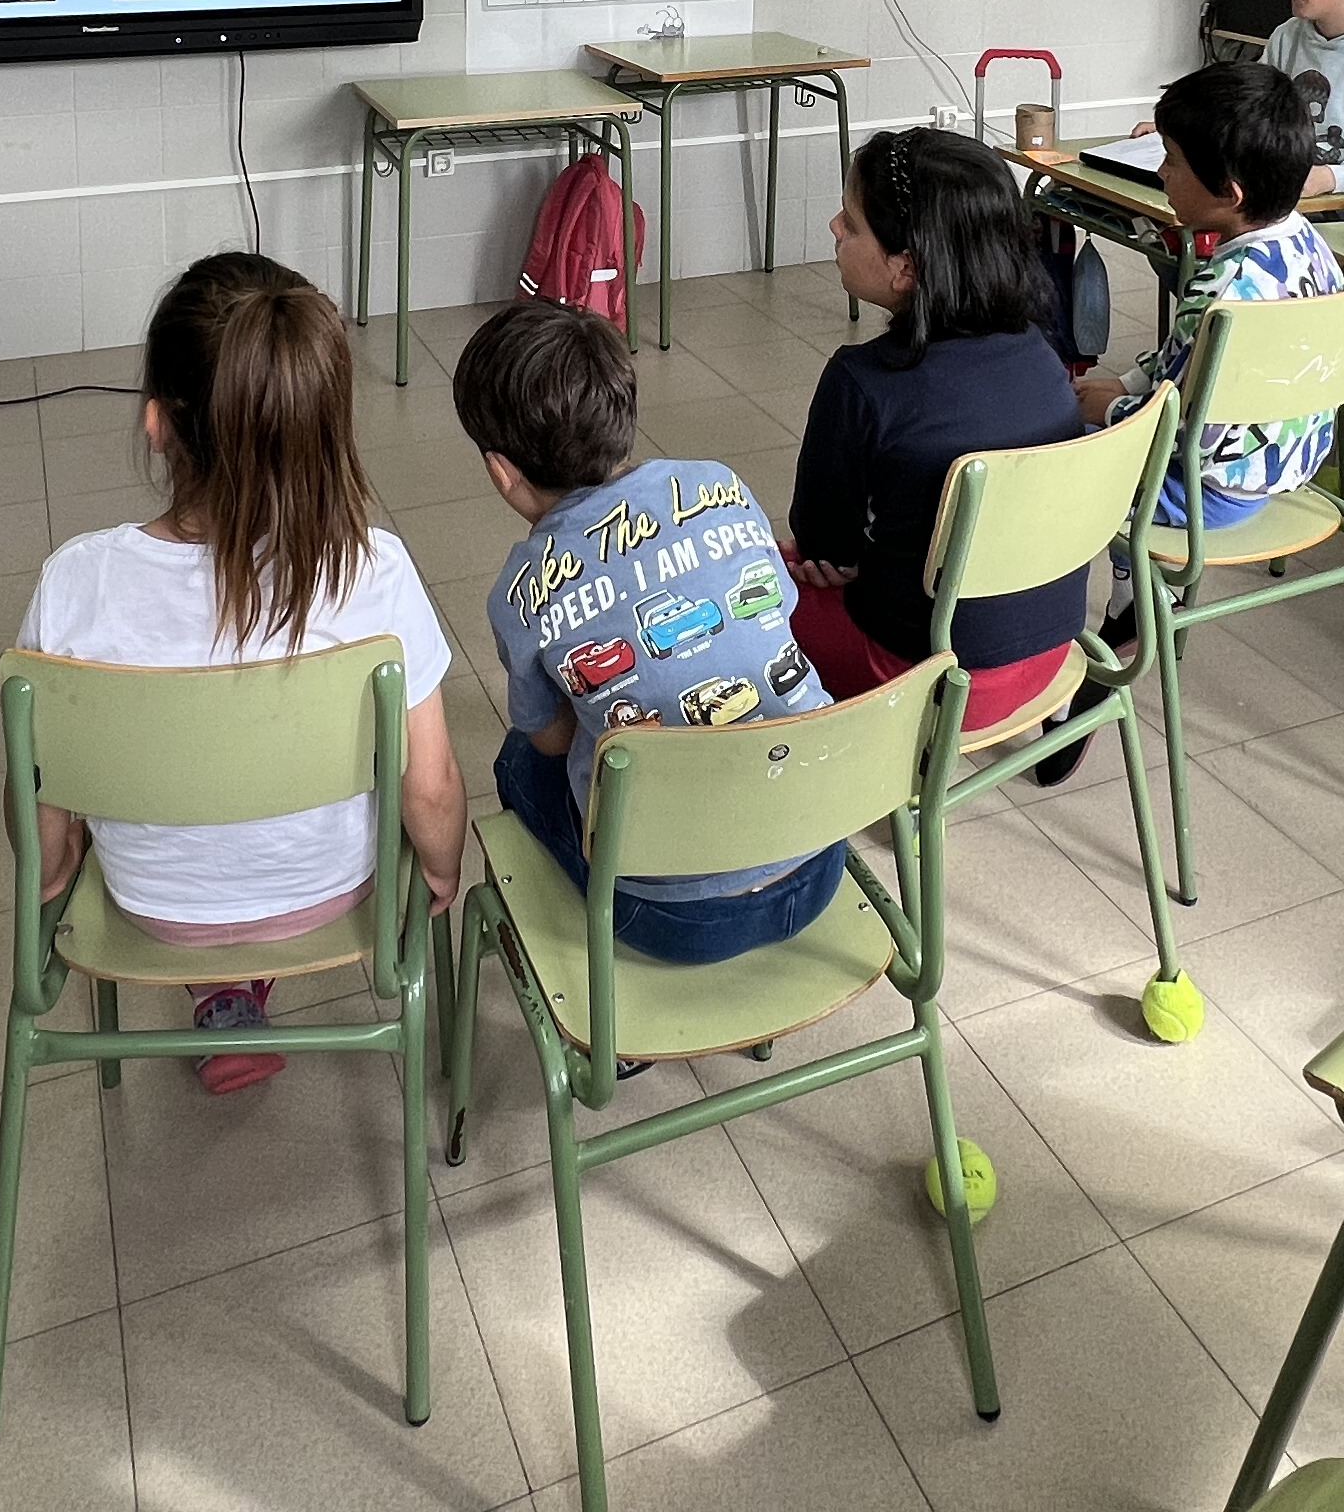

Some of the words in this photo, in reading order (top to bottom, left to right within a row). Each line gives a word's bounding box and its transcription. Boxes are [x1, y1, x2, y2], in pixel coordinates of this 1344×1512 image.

[506, 534, 585, 629] Take
[582, 499, 661, 564] The
[670, 470, 751, 528] Lead
[538, 574, 628, 650] SPEED.
[633, 559, 648, 592] I
[656, 537, 701, 584] AM
